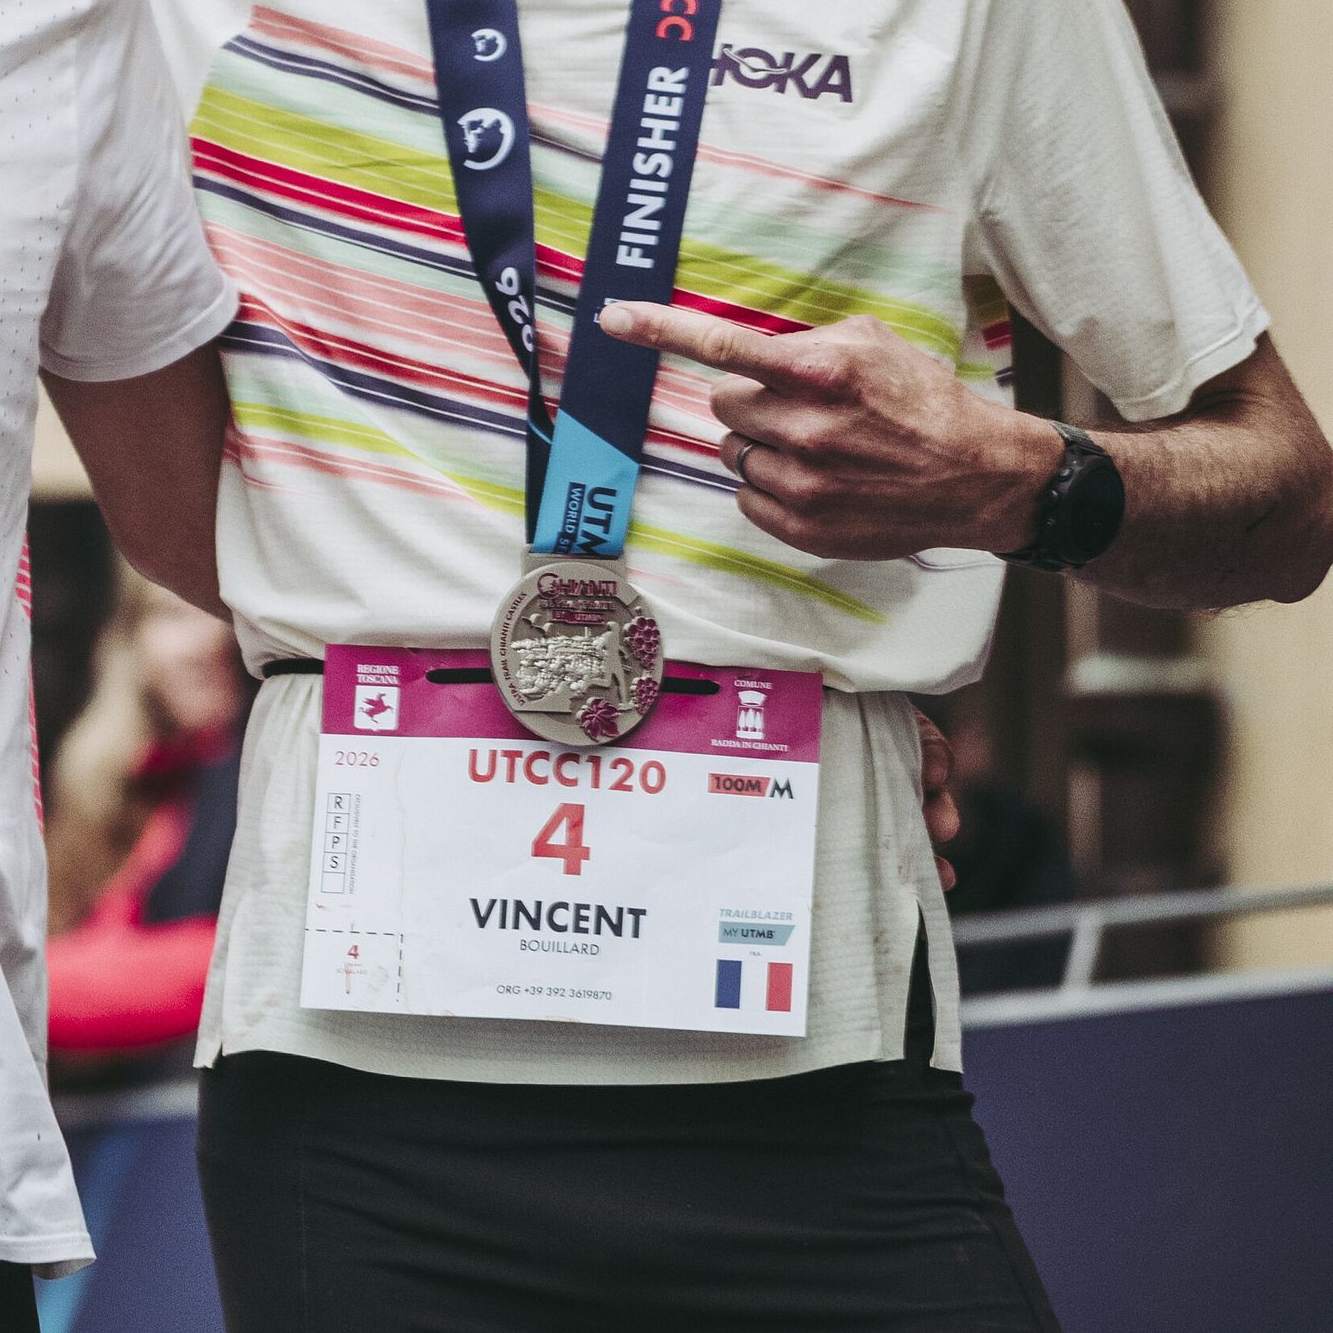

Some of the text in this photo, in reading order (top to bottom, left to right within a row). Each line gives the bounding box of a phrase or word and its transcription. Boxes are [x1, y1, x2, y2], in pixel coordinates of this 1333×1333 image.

[615, 66, 689, 269] FINISHER
[565, 487, 583, 535] WORLD
[537, 572, 618, 600] CHIANTI
[499, 621, 510, 657] CHIANTI
[505, 591, 528, 621] CASTLES
[356, 663, 401, 675] REGIONE
[733, 679, 773, 691] COMUNE
[710, 738, 789, 753] RADDA IN CHIANTI
[334, 750, 380, 768] 2026
[467, 748, 667, 795] UTCC120
[714, 775, 762, 793] 100M
[334, 795, 343, 810] R
[333, 815, 342, 829] F
[332, 835, 340, 850] P
[531, 802, 591, 876] 4
[331, 855, 339, 869] S
[468, 897, 648, 940] VINCENT
[719, 908, 794, 921] TRAILBLAZER
[723, 928, 774, 939] MY UTMB
[347, 944, 360, 960] 4
[519, 939, 600, 956] BOUILLARD
[496, 984, 613, 1001] ORG +39 392 3619870
